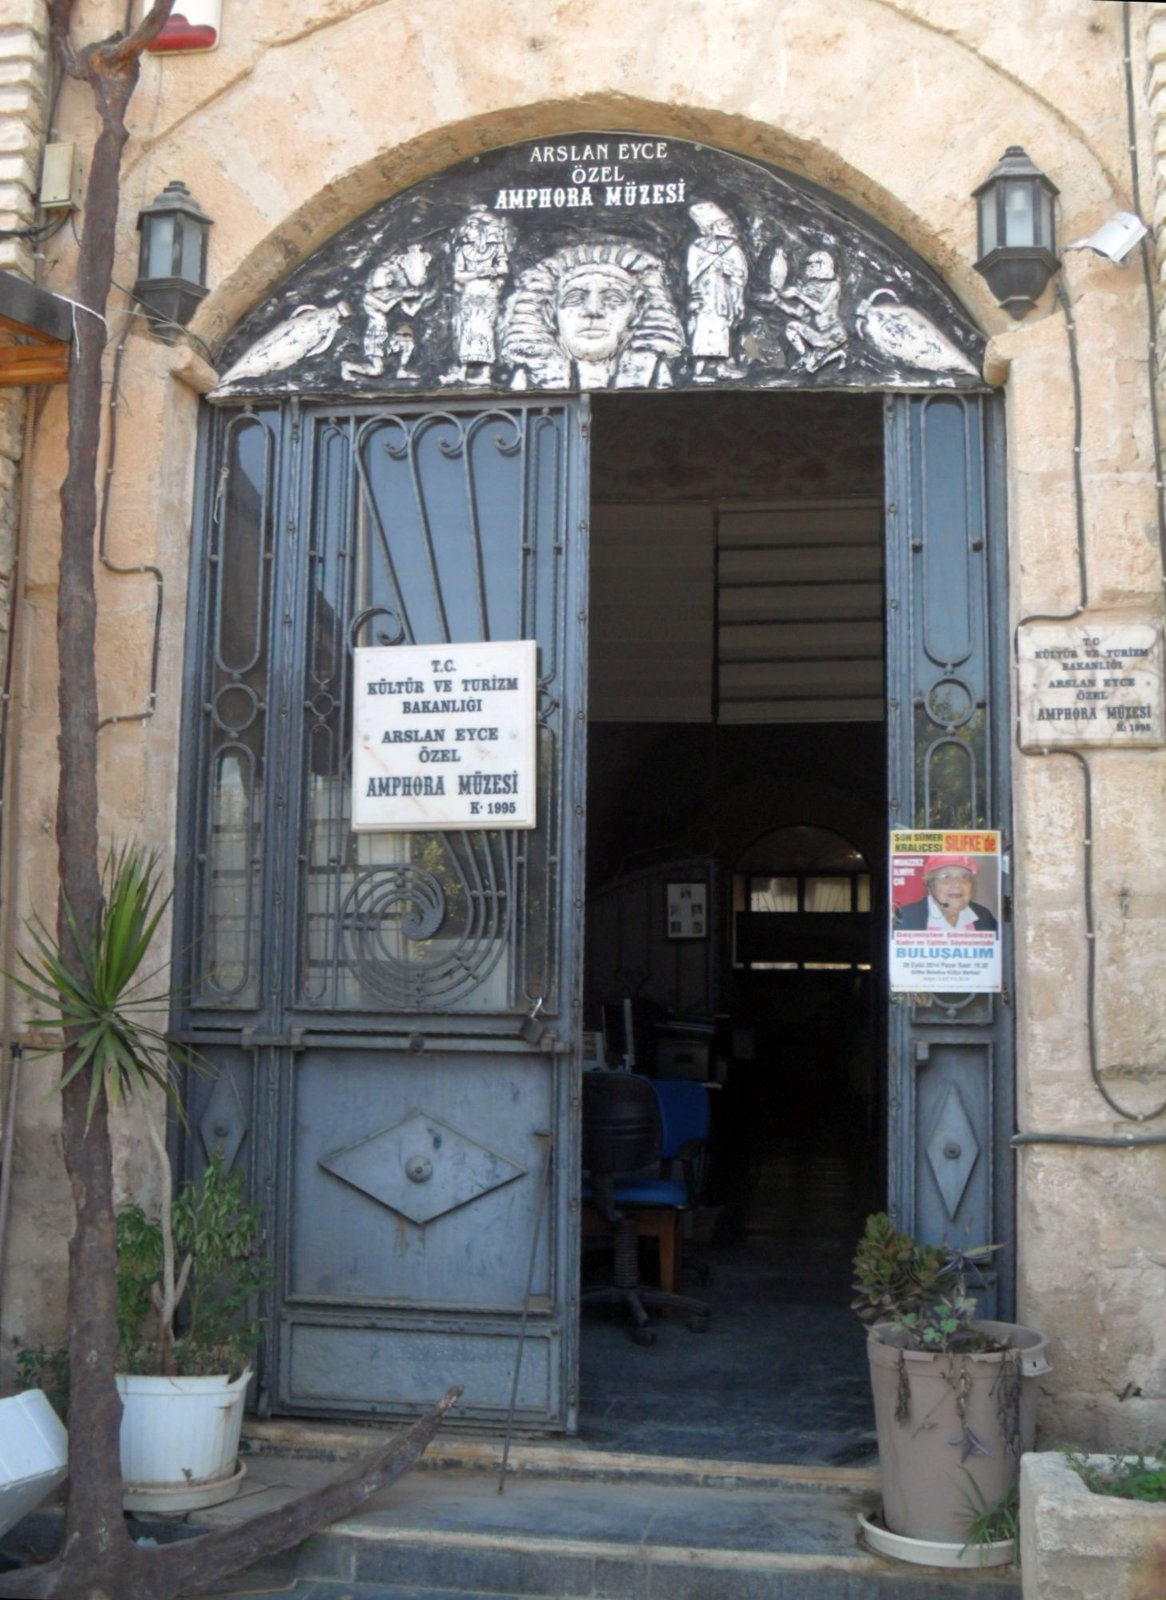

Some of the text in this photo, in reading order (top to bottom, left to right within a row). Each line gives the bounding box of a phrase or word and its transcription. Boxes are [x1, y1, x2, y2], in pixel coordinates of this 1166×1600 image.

[530, 142, 668, 163] ARSLAN EYCE
[571, 165, 625, 184] ÖZEL
[494, 178, 686, 210] AMPHORA MÜZESİ
[1035, 646, 1149, 659] KÜLTÜR VE TURİZM
[431, 660, 456, 673] T.C.
[1062, 660, 1122, 671] BAKANLIĞI
[367, 675, 518, 695] KÜLTÜR VE TURİZM
[1048, 678, 1135, 688] ARSLAN EYCE
[1076, 690, 1109, 701] ÖZEL
[402, 697, 482, 714] BAKANLIĞI
[1037, 703, 1152, 721] AMPHORA MÜZESİ
[381, 727, 498, 744] ARSLAN EYCE
[418, 746, 461, 763] ÖZEL
[366, 770, 518, 797] AMPHORA MÜZESİ
[487, 802, 516, 814] 1995
[896, 947, 994, 959] BULUŞALIM
